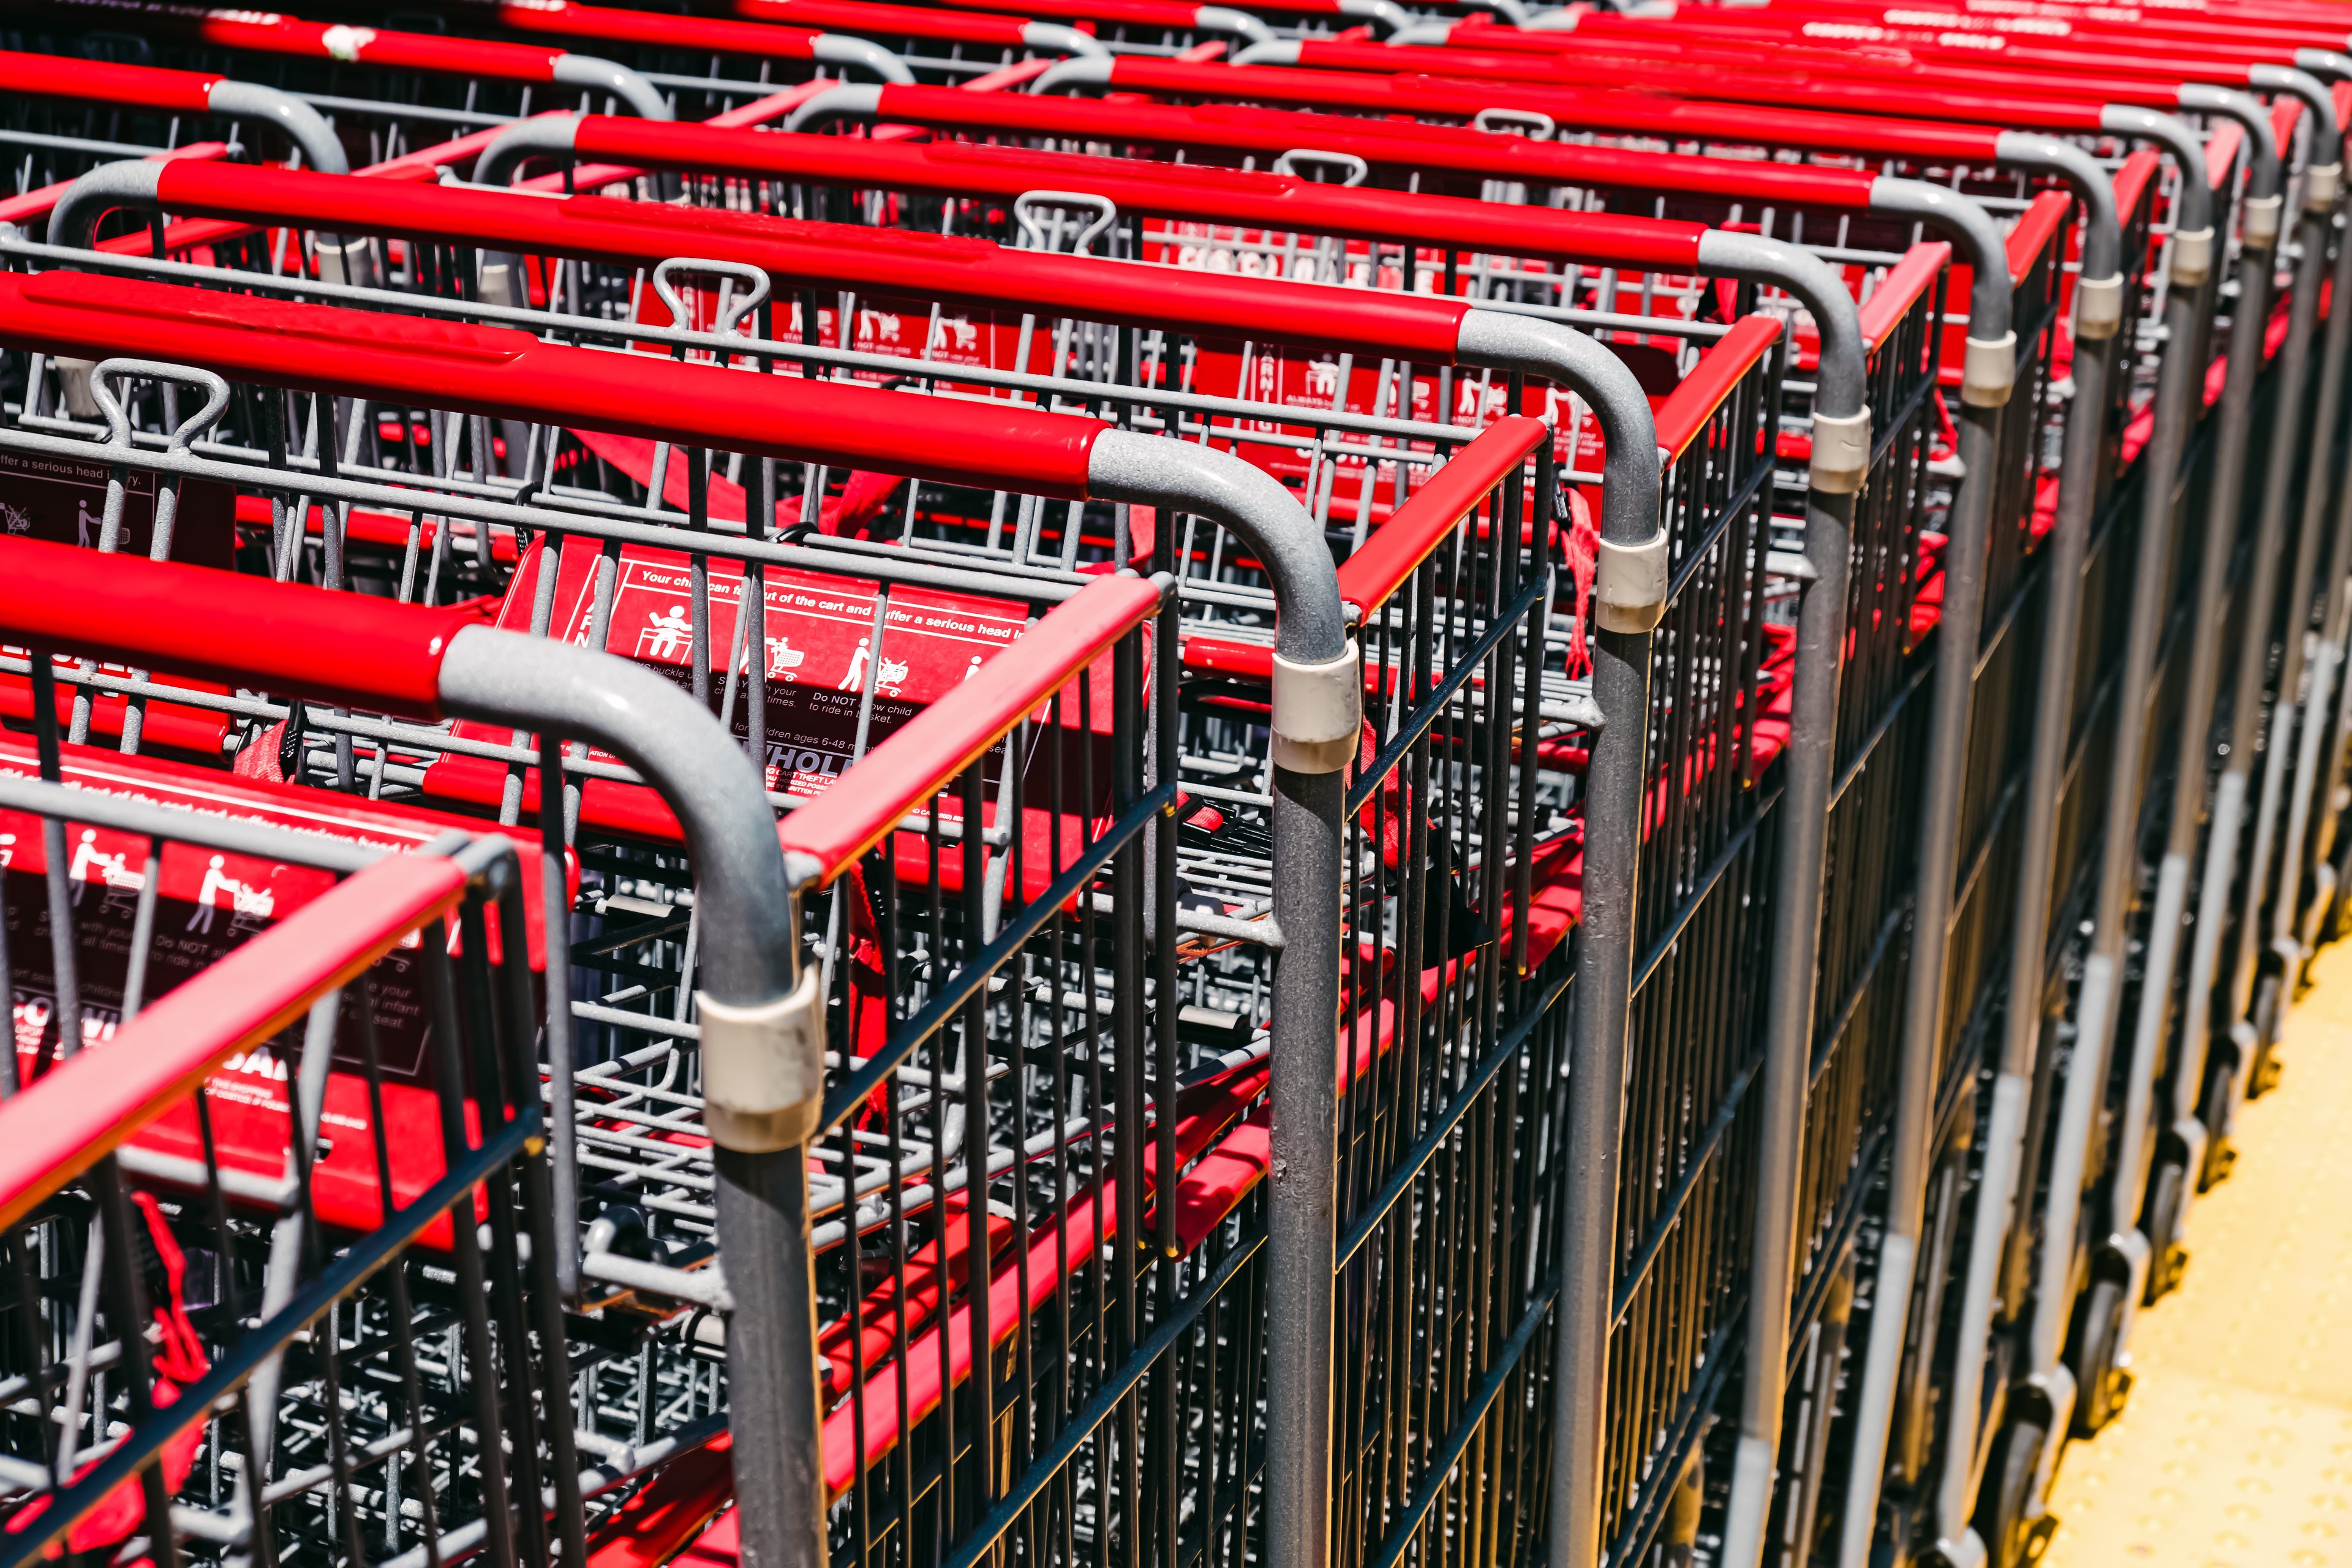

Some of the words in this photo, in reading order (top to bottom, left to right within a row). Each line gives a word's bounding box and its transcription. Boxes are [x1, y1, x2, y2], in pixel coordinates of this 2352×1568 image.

[1, 454, 18, 466] ffer
[32, 461, 73, 474] serious
[77, 466, 103, 478] head
[643, 570, 672, 584] Your
[708, 583, 729, 594] can
[764, 592, 777, 601] ut
[778, 594, 794, 603] of
[795, 595, 816, 607] the
[819, 599, 845, 612] cart
[846, 604, 872, 616] and
[884, 609, 913, 624] uffer
[914, 616, 923, 624] a
[925, 614, 975, 633] serious
[977, 621, 1011, 639] head
[773, 687, 797, 697] your
[813, 692, 828, 701] Do
[831, 695, 856, 706] NOT
[858, 701, 886, 711] aow
[888, 706, 912, 716] child
[809, 702, 819, 710] to
[821, 704, 841, 715] ride
[843, 708, 853, 717] in
[735, 722, 748, 732] for
[766, 728, 791, 739] ldren
[794, 733, 819, 744] ages
[821, 737, 845, 748] 6-48
[799, 772, 824, 783] THEFT
